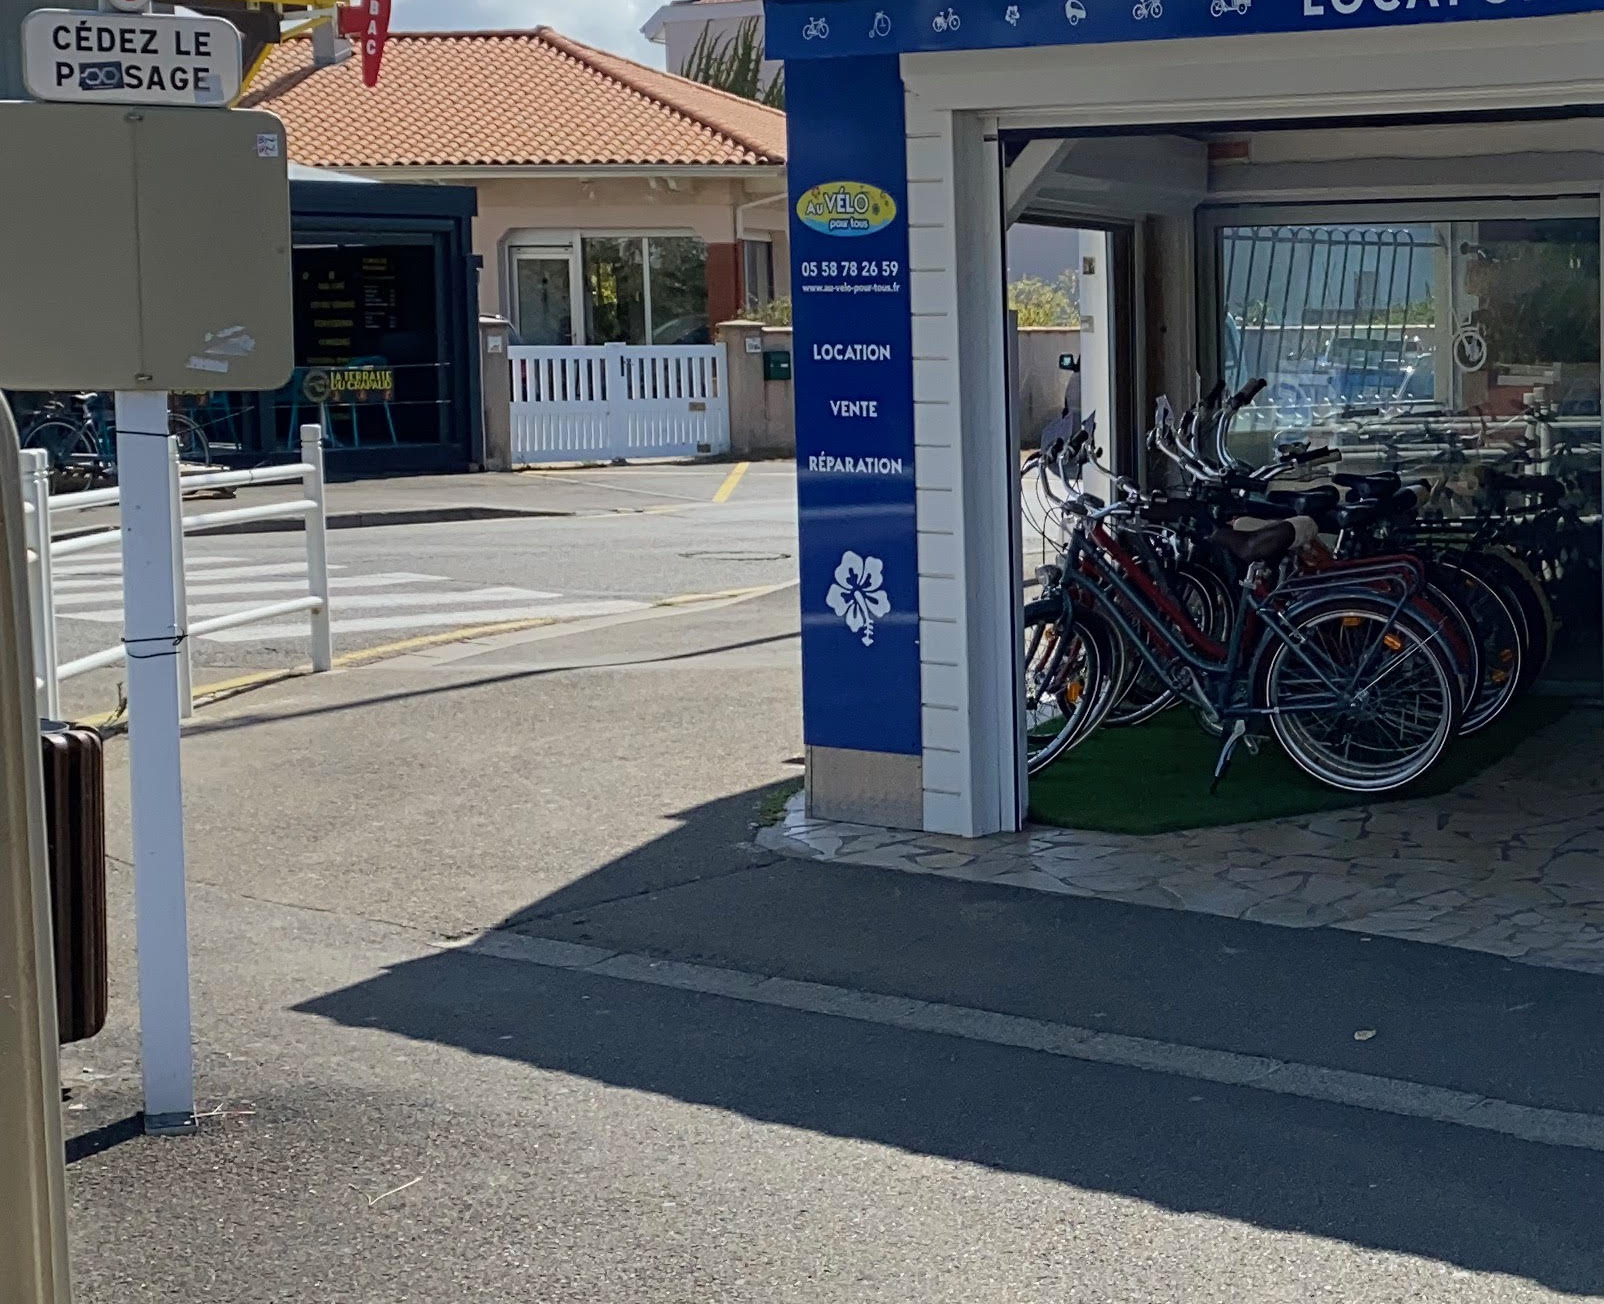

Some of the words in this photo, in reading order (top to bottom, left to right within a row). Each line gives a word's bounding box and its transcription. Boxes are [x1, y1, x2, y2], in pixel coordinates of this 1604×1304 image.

[53, 20, 159, 55] CÉDEZ
[175, 30, 212, 57] LE
[55, 60, 211, 92] PSAGE
[824, 187, 869, 215] VÉLO
[828, 219, 849, 230] pour
[850, 216, 869, 229] tous
[802, 261, 818, 277] 05
[821, 261, 838, 277] 58
[841, 261, 858, 276] 78
[861, 261, 878, 276] 26
[882, 260, 899, 276] 59
[813, 343, 891, 361] LOCATION
[829, 399, 878, 418] VENTE
[808, 452, 903, 475] RÉPARATION
